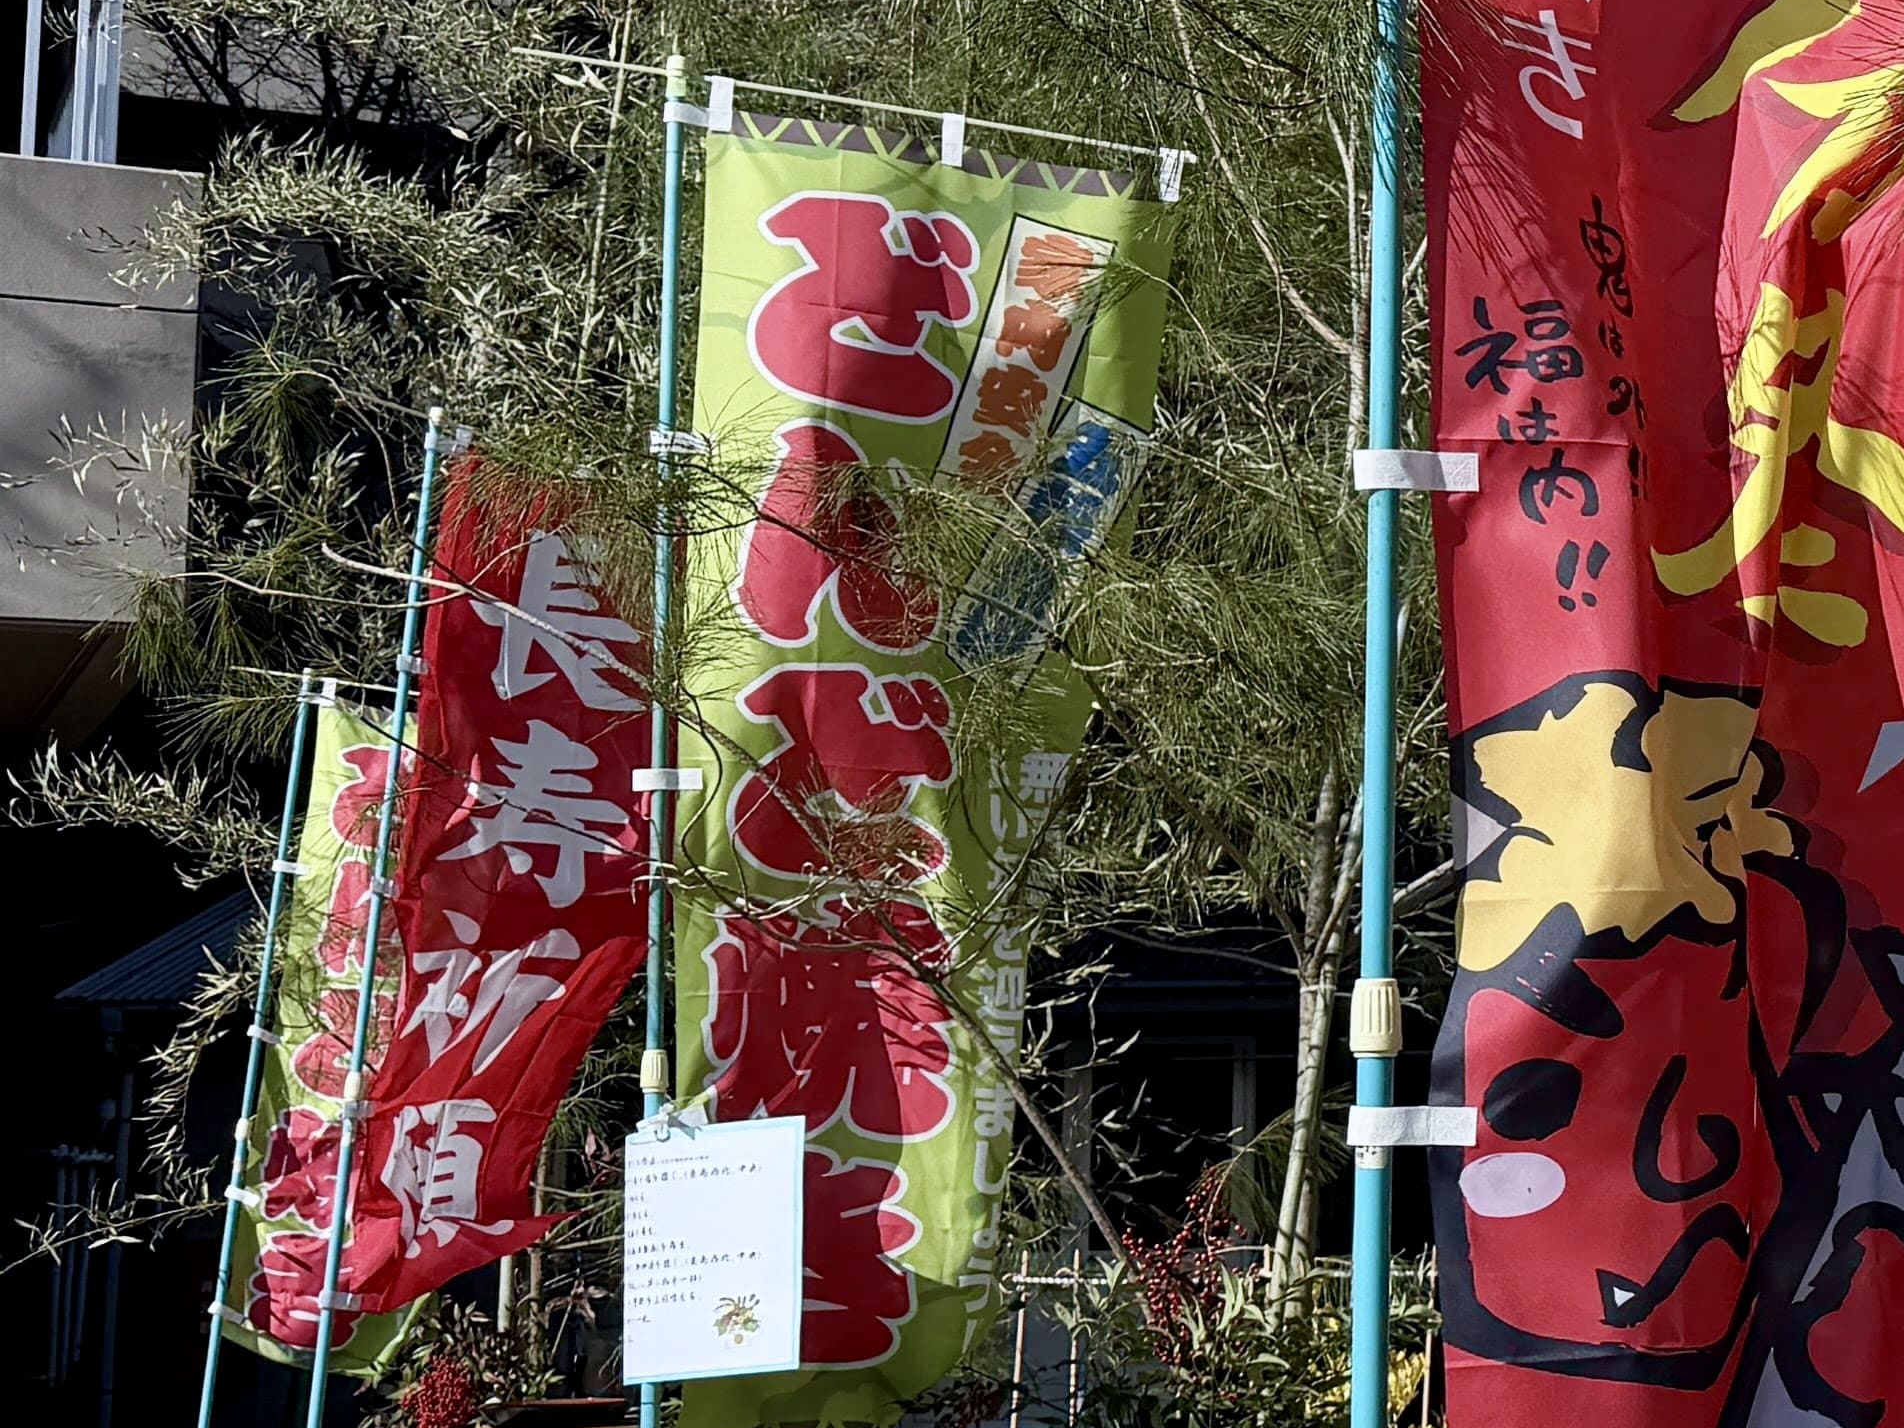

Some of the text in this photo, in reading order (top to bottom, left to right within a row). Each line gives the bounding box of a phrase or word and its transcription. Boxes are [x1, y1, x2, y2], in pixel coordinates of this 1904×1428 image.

[1455, 296, 1610, 612] 福は内!!
[384, 529, 641, 1260] 長寿祈願
